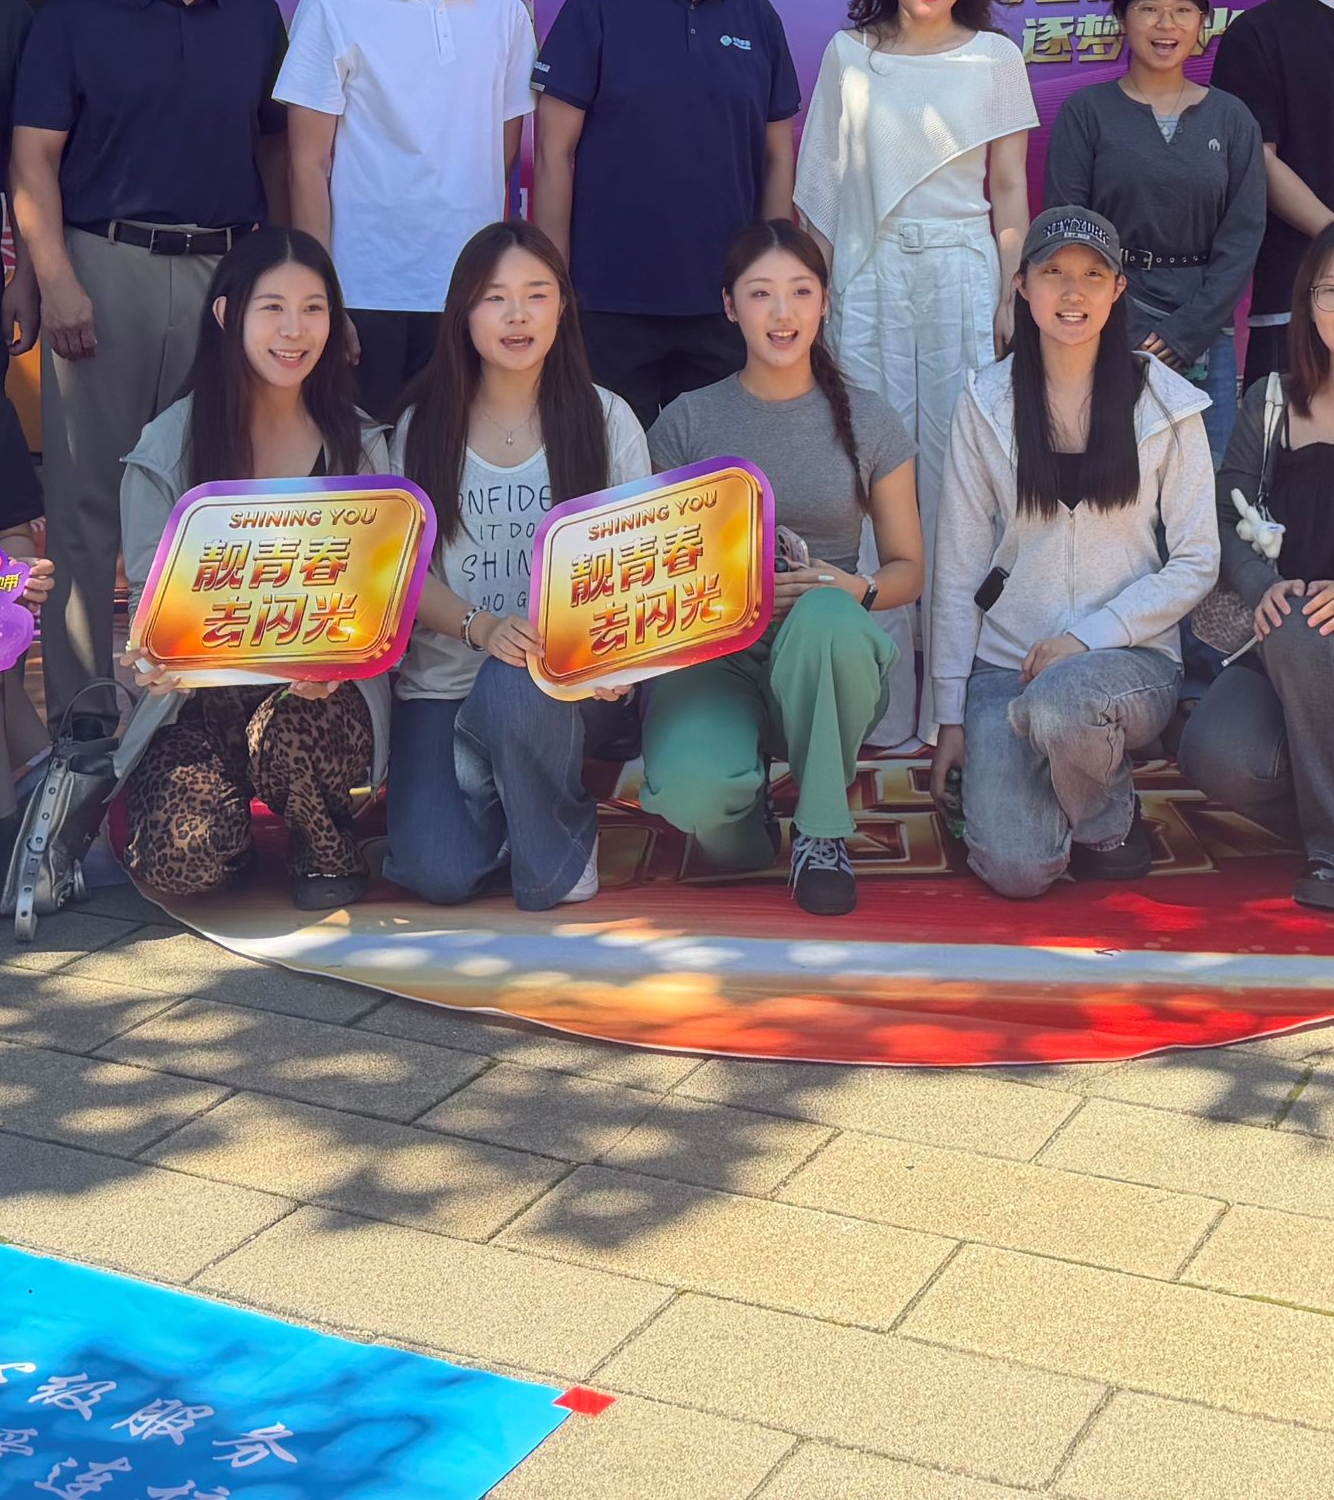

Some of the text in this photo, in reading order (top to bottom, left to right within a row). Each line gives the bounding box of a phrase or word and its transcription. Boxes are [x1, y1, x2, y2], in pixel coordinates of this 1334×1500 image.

[228, 506, 378, 530] SHINING YOU
[588, 489, 718, 542] SHINING YOU
[191, 536, 352, 592] 靓青春
[570, 523, 704, 608] 靓青春
[201, 592, 358, 649] 去闪光
[589, 573, 722, 656] 去闪光
